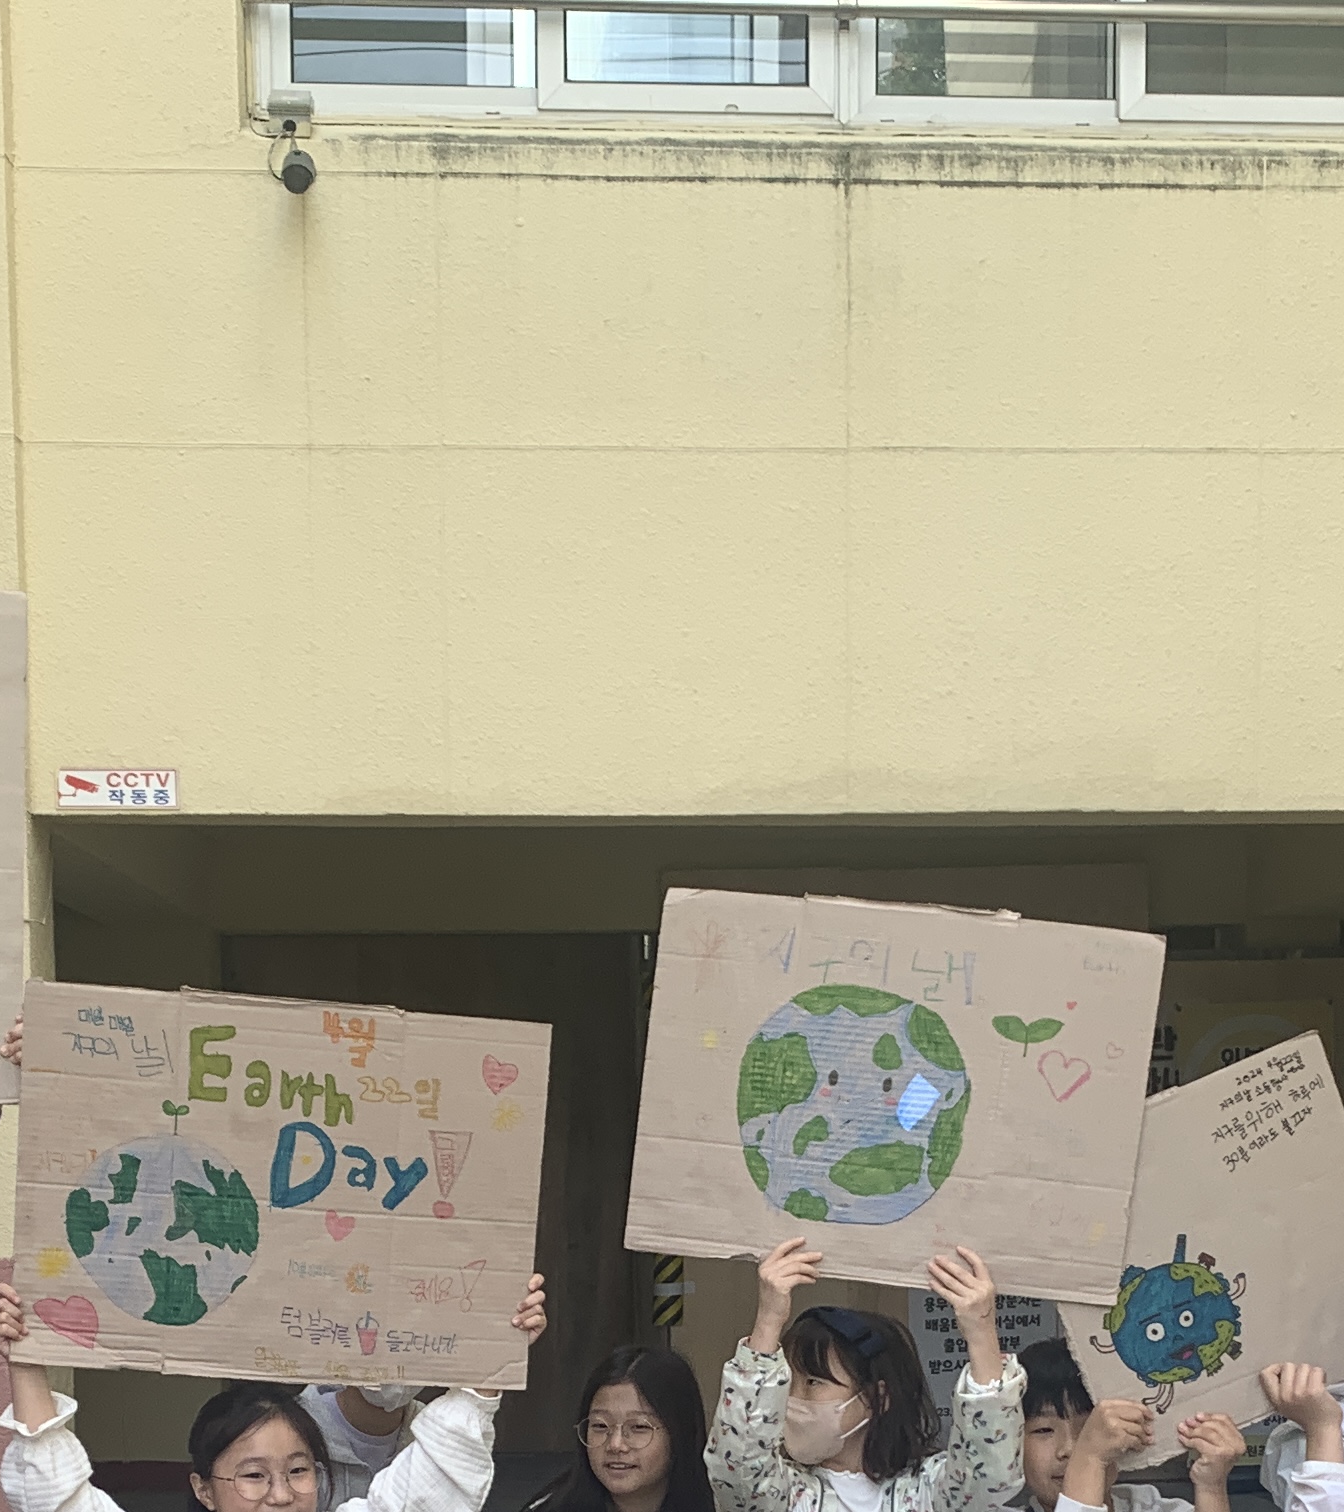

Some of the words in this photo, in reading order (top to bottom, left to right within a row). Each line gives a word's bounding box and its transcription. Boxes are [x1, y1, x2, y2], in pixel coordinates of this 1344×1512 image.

[106, 772, 170, 788] CCTV
[108, 789, 170, 805] 작동중
[188, 1024, 353, 1127] Earth
[357, 1076, 442, 1121] 22일
